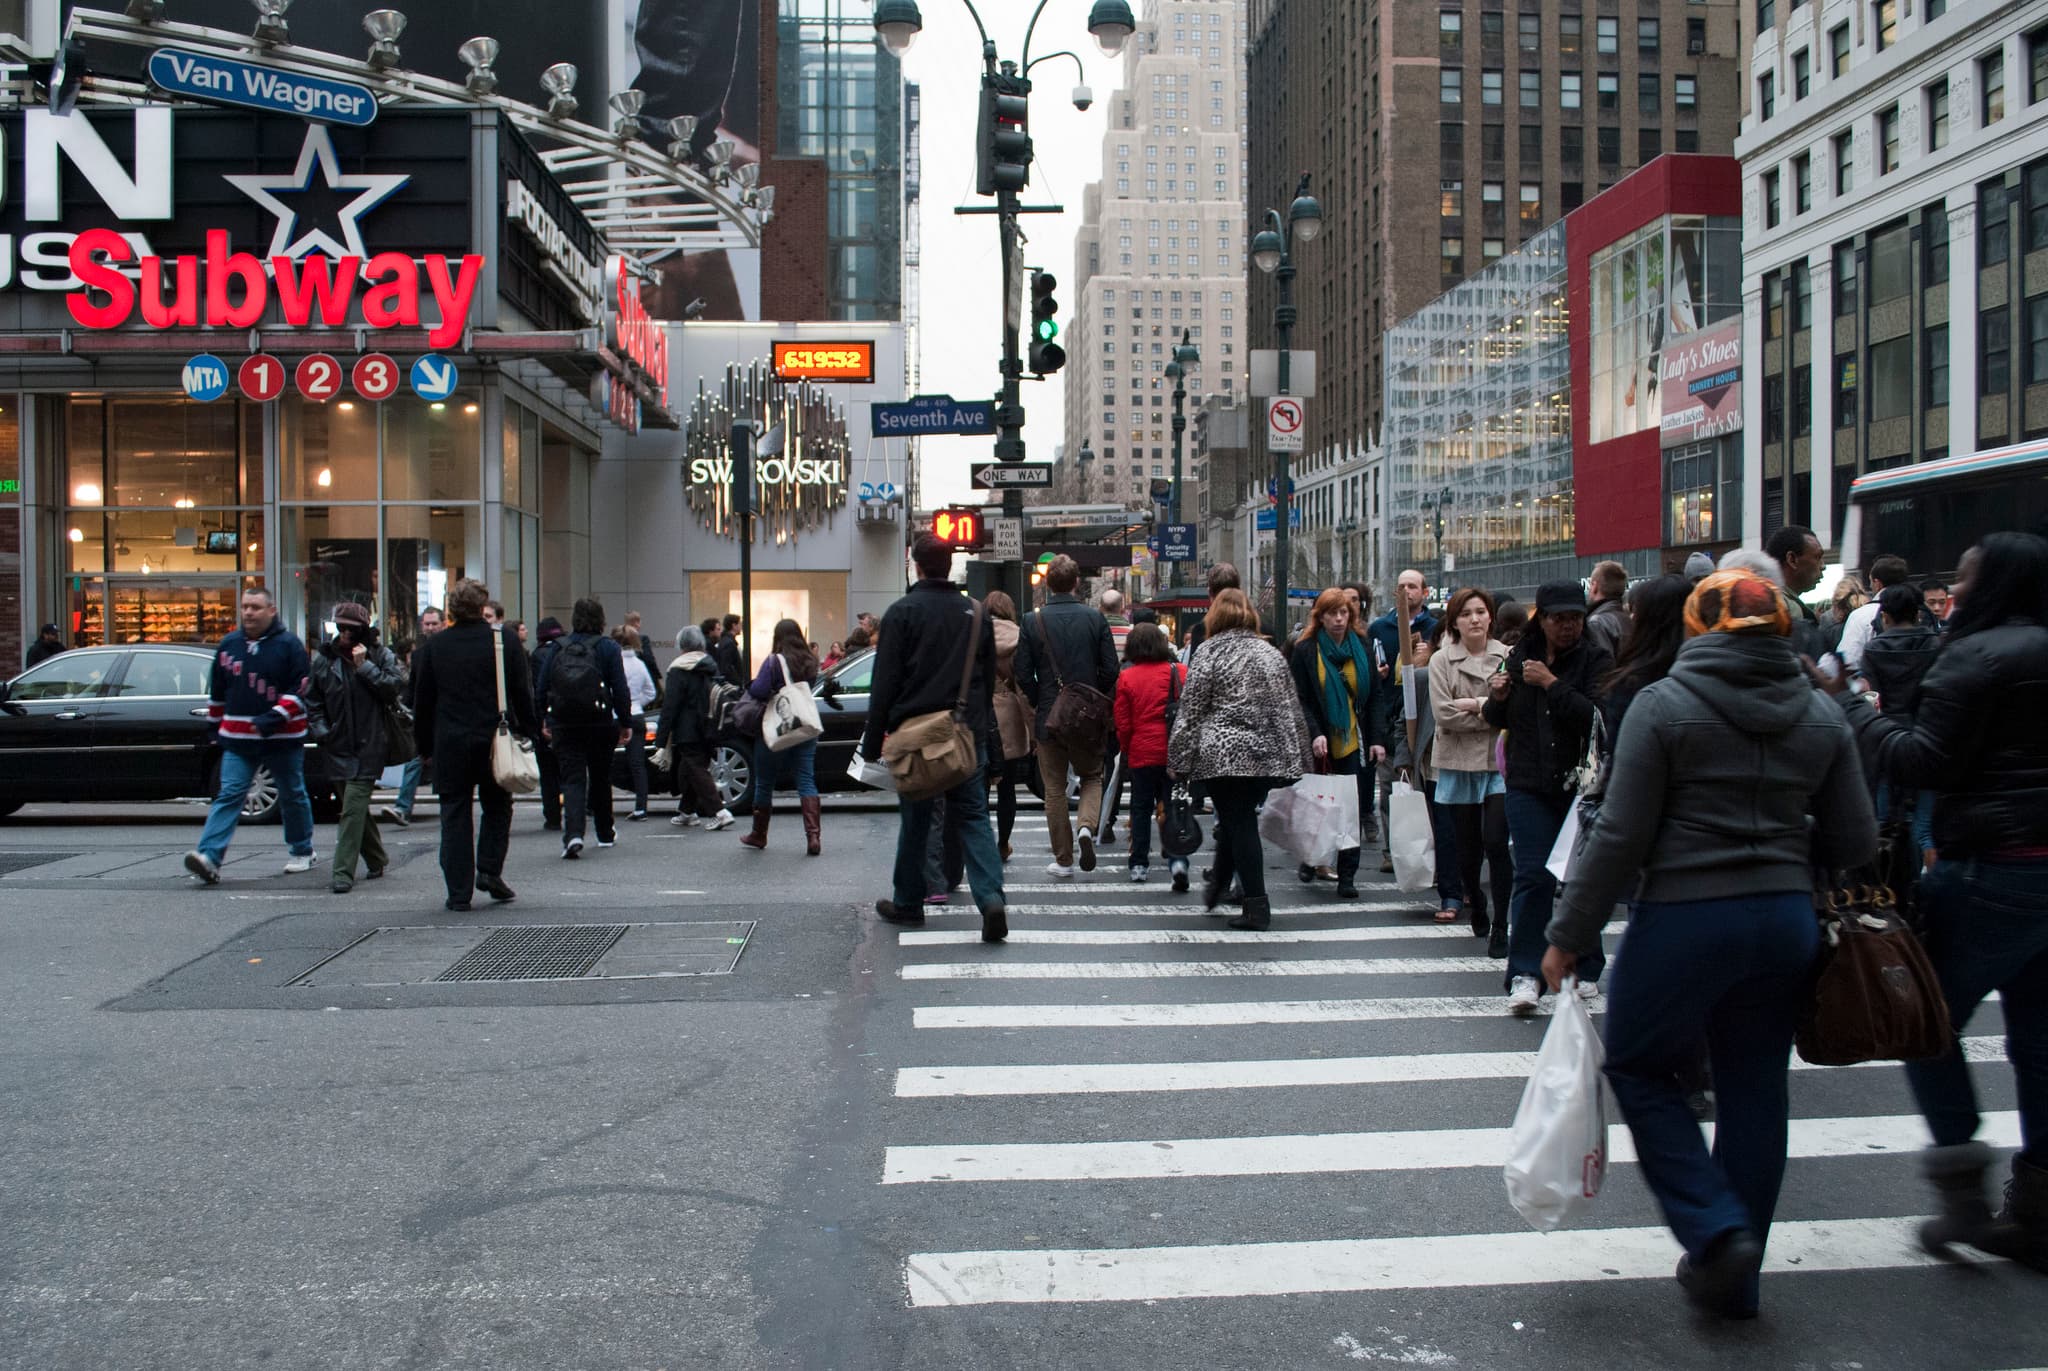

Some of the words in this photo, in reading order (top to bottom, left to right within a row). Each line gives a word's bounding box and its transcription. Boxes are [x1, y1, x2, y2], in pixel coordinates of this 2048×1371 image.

[169, 56, 233, 92] Van
[242, 69, 365, 115] Wagner
[66, 228, 485, 348] Subway
[1663, 348, 1698, 381] Lady's
[1700, 339, 1740, 369] Shoes
[184, 365, 222, 394] MTA
[253, 363, 268, 394] 1
[308, 361, 331, 393] 2
[364, 361, 389, 393] 3
[1689, 377, 1714, 393] TANNERY
[1715, 369, 1737, 385] HOUSE
[879, 409, 946, 428] Seventh
[953, 409, 984, 425] Ave
[1693, 415, 1724, 440] Lady's
[983, 471, 1007, 481] ONE
[1018, 470, 1042, 480] WAY
[1036, 517, 1058, 526] Long
[1059, 515, 1085, 525] Island
[1087, 515, 1105, 523] Rail
[1107, 514, 1128, 523] Road
